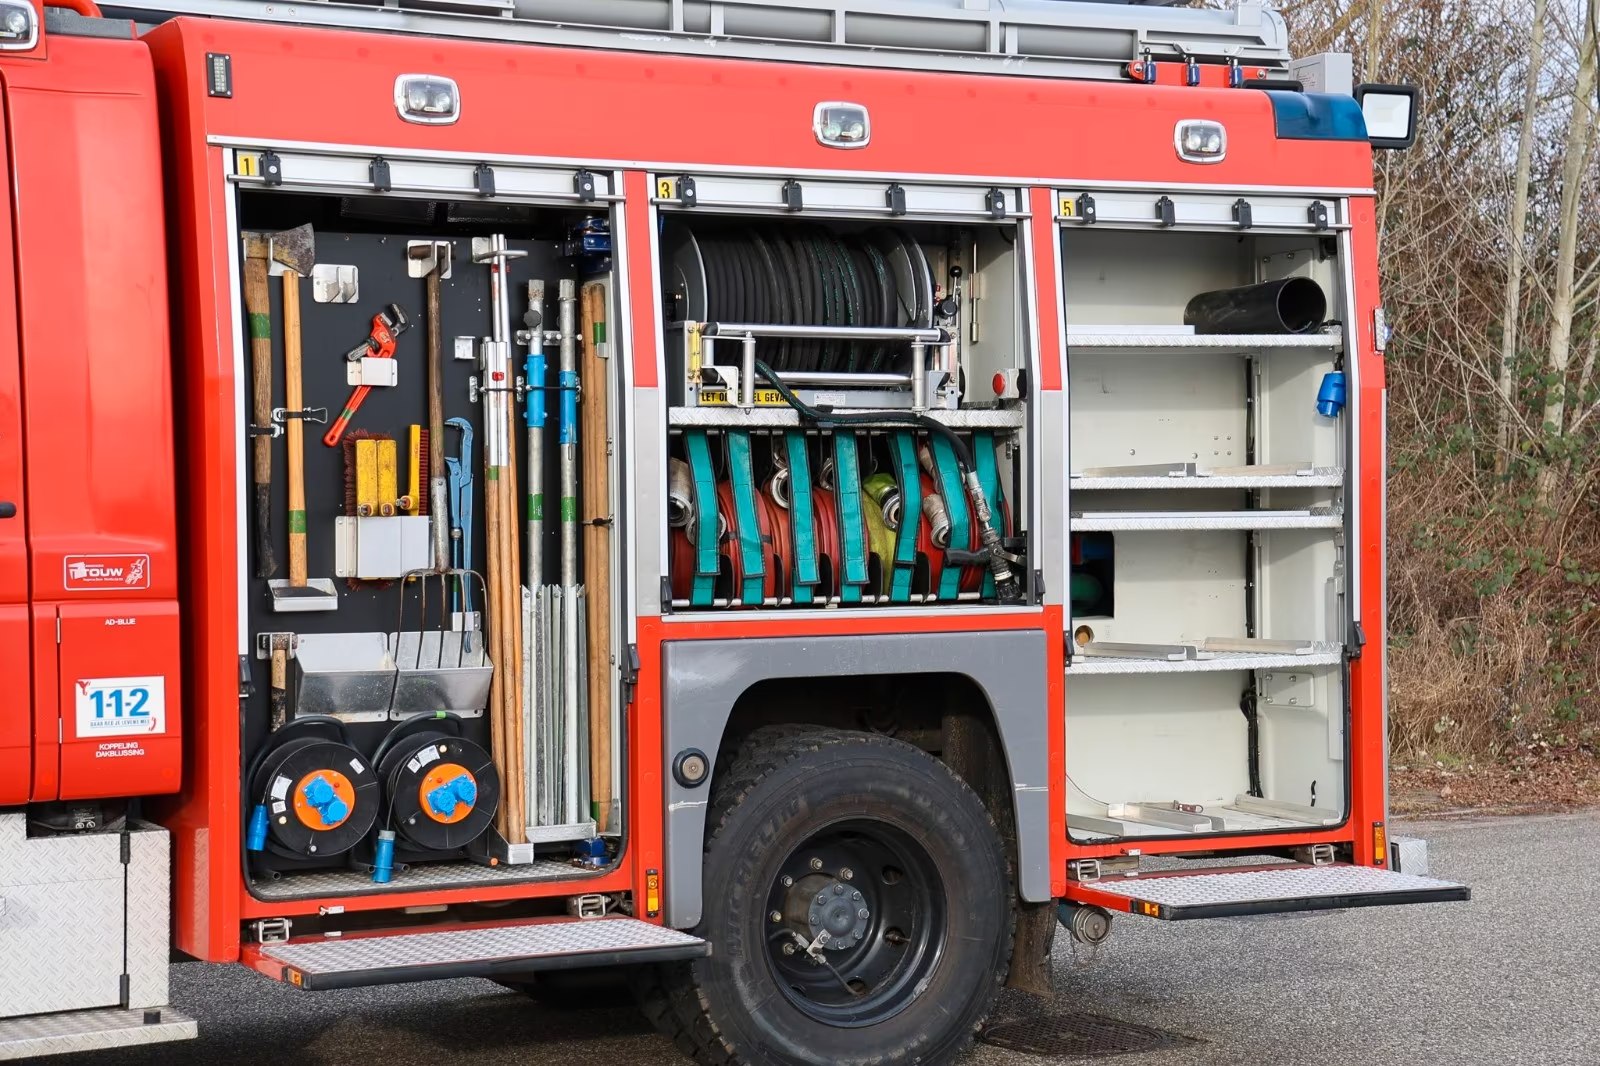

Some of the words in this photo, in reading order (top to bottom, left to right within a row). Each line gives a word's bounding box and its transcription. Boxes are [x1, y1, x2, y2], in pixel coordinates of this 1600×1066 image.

[243, 157, 250, 176] 1
[661, 181, 671, 199] 3
[1063, 200, 1072, 217] 5
[701, 392, 716, 402] LET
[104, 618, 136, 626] AD-BLUE
[90, 688, 150, 718] 1-1-2
[99, 742, 139, 750] KOPPELING
[95, 749, 145, 758] DAKBLUSSING
